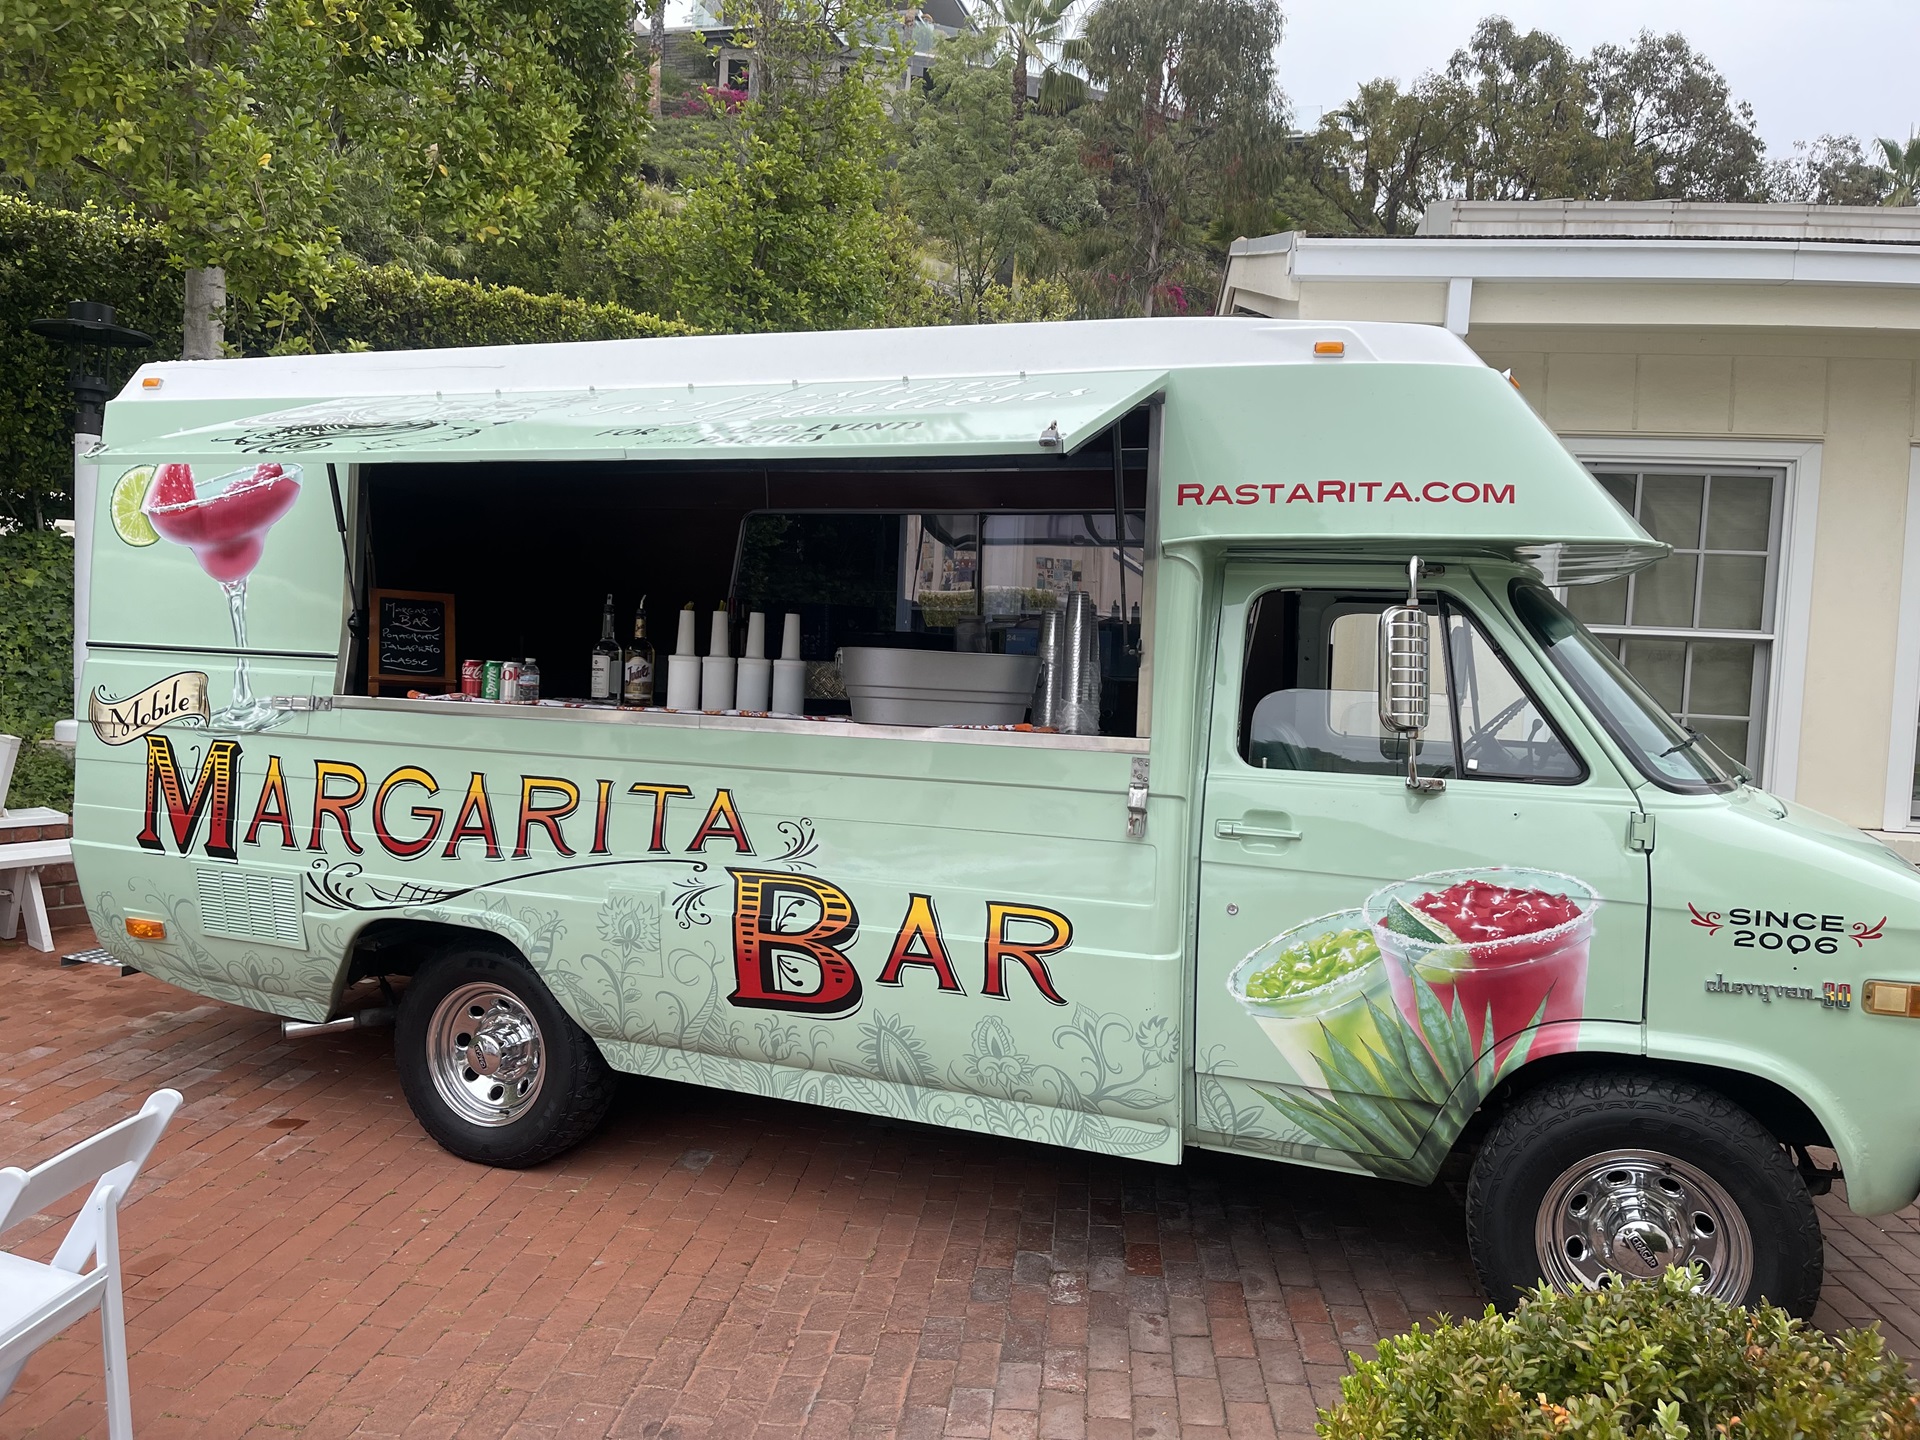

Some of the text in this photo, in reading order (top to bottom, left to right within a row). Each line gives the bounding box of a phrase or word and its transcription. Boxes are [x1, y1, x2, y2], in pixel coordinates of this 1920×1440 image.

[594, 427, 660, 437] FOR
[707, 425, 799, 435] YOUR
[805, 421, 925, 432] EVENTS
[691, 432, 828, 445] PARTIES
[1177, 479, 1515, 506] RASTARITA.COM
[398, 614, 432, 628] BAR
[381, 653, 429, 666] CLASSIC
[485, 666, 497, 695] Sprite
[108, 680, 190, 738] Mobile
[137, 734, 753, 863] MARGARITA
[1729, 908, 1845, 933] SINCE
[725, 867, 1074, 1020] BAR
[1733, 930, 1838, 954] 2006
[1821, 981, 1851, 1010] 30
[1632, 1236, 1657, 1267] CRAGAR
